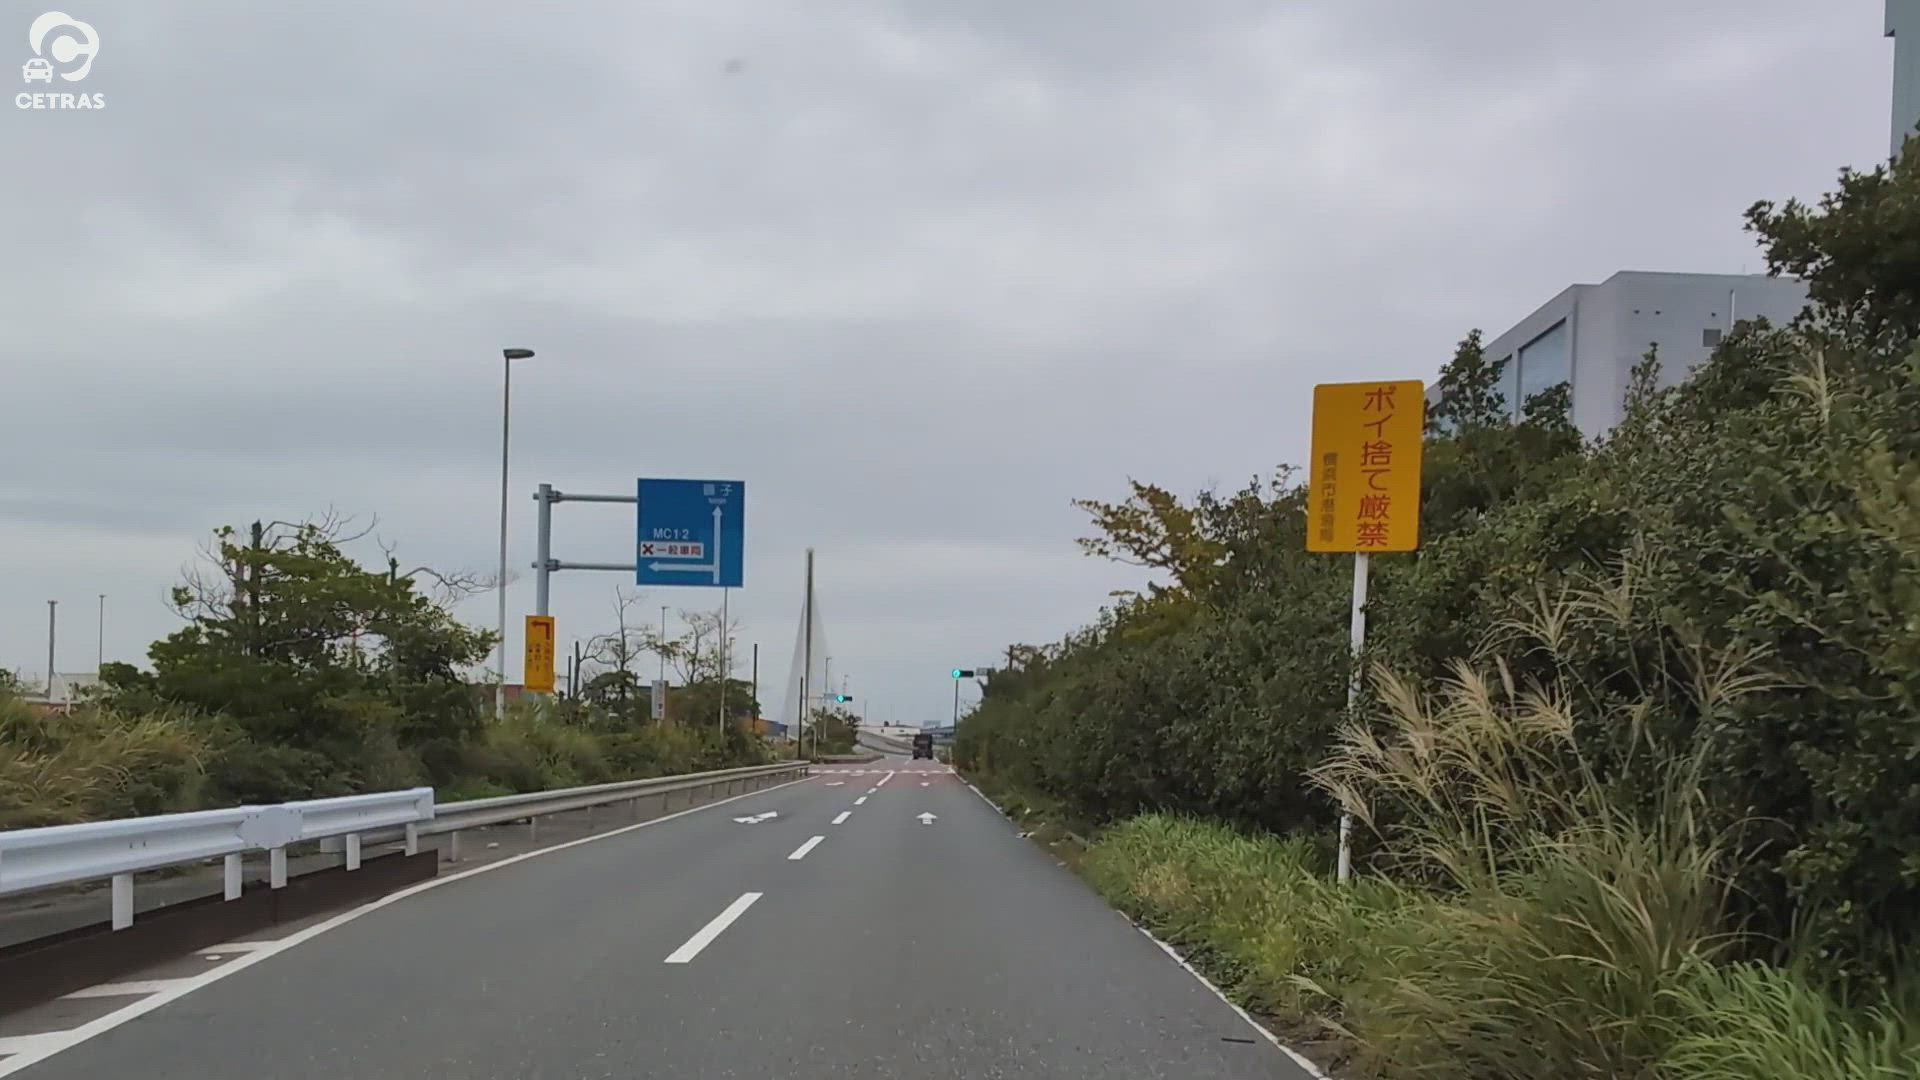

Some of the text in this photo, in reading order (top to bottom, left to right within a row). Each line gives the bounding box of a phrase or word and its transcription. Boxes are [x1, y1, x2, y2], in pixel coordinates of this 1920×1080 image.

[704, 484, 733, 496] 子
[1357, 384, 1397, 547] ポイ捨て厳禁
